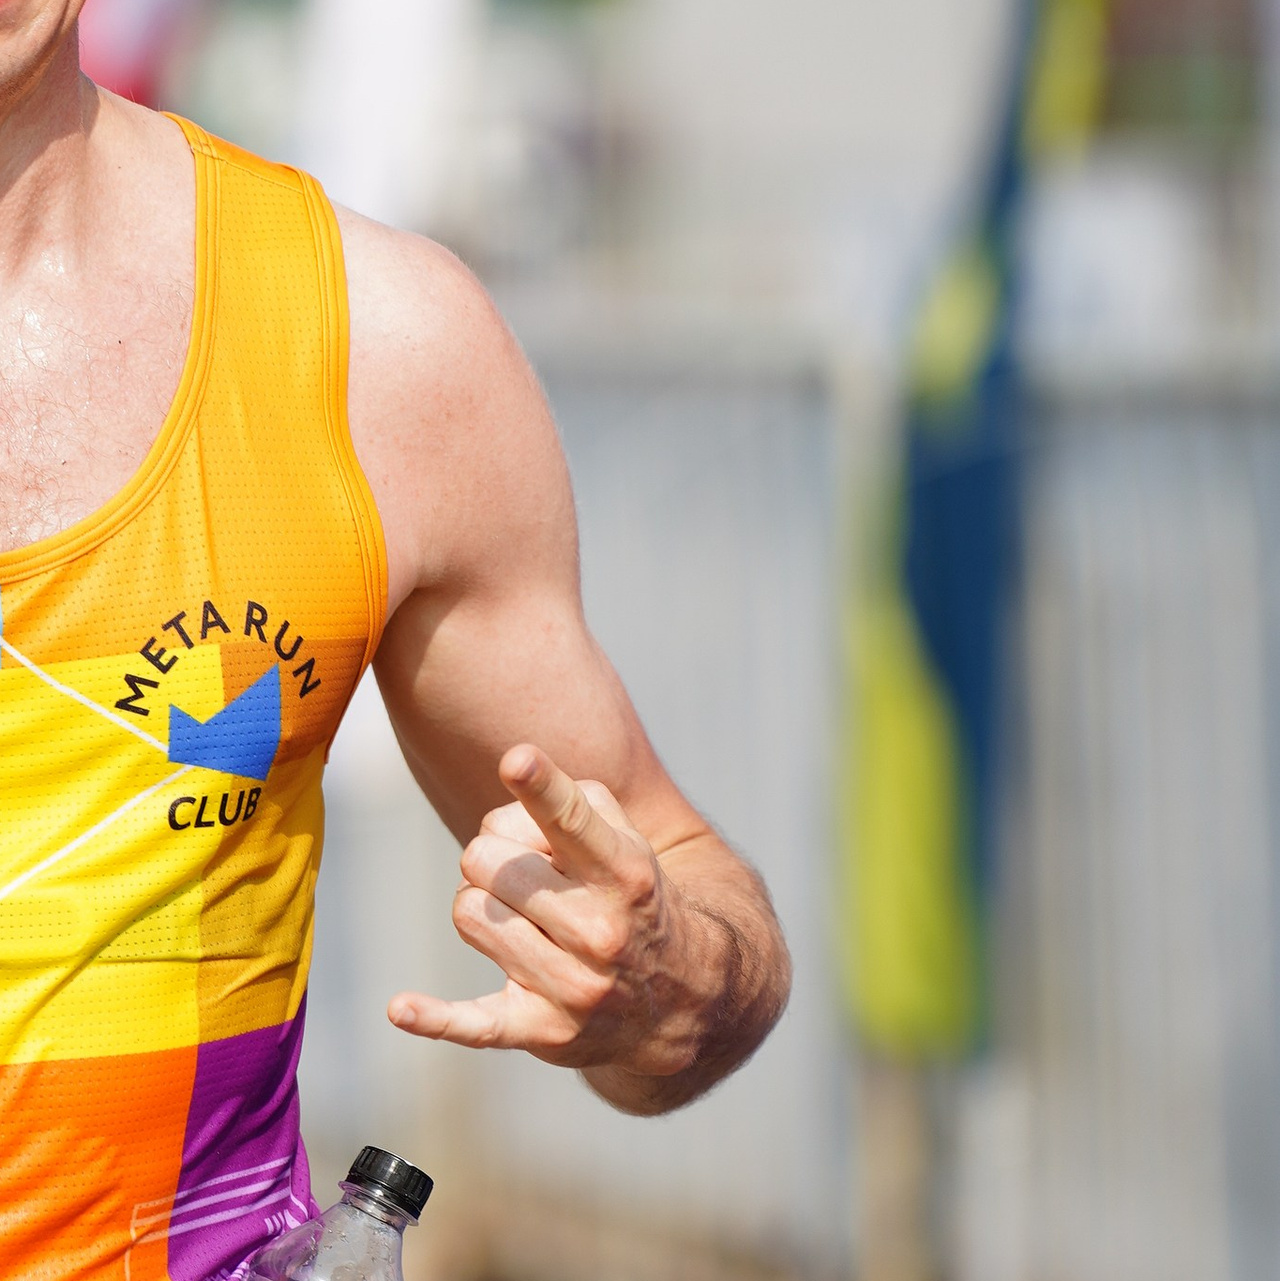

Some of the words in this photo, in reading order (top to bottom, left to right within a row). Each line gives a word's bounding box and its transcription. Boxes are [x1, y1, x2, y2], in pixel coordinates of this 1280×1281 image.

[114, 600, 231, 716] META
[243, 600, 321, 699] RUN
[167, 787, 262, 830] CLUB
